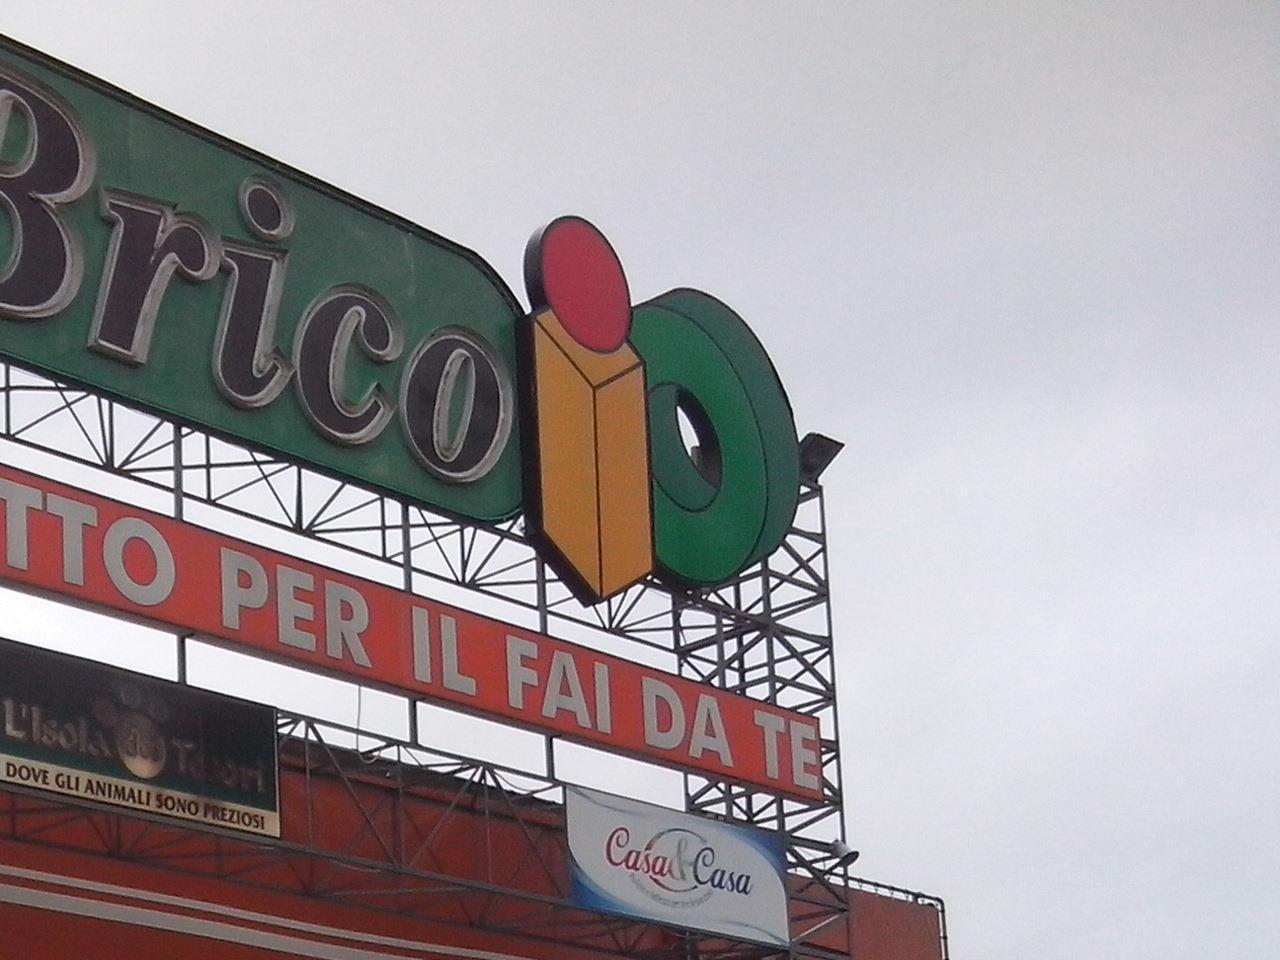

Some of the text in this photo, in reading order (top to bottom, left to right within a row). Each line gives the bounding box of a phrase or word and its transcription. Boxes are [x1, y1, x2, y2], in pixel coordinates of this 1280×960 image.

[221, 547, 372, 668] PER
[412, 605, 476, 696] IL
[505, 634, 611, 734] FAI
[642, 676, 734, 767] DA
[754, 710, 819, 790] TE
[6, 761, 265, 830] DOVE GLI ANIMALI SONO PREZIOSI
[606, 827, 669, 875] Casa
[693, 846, 753, 895] Casa
